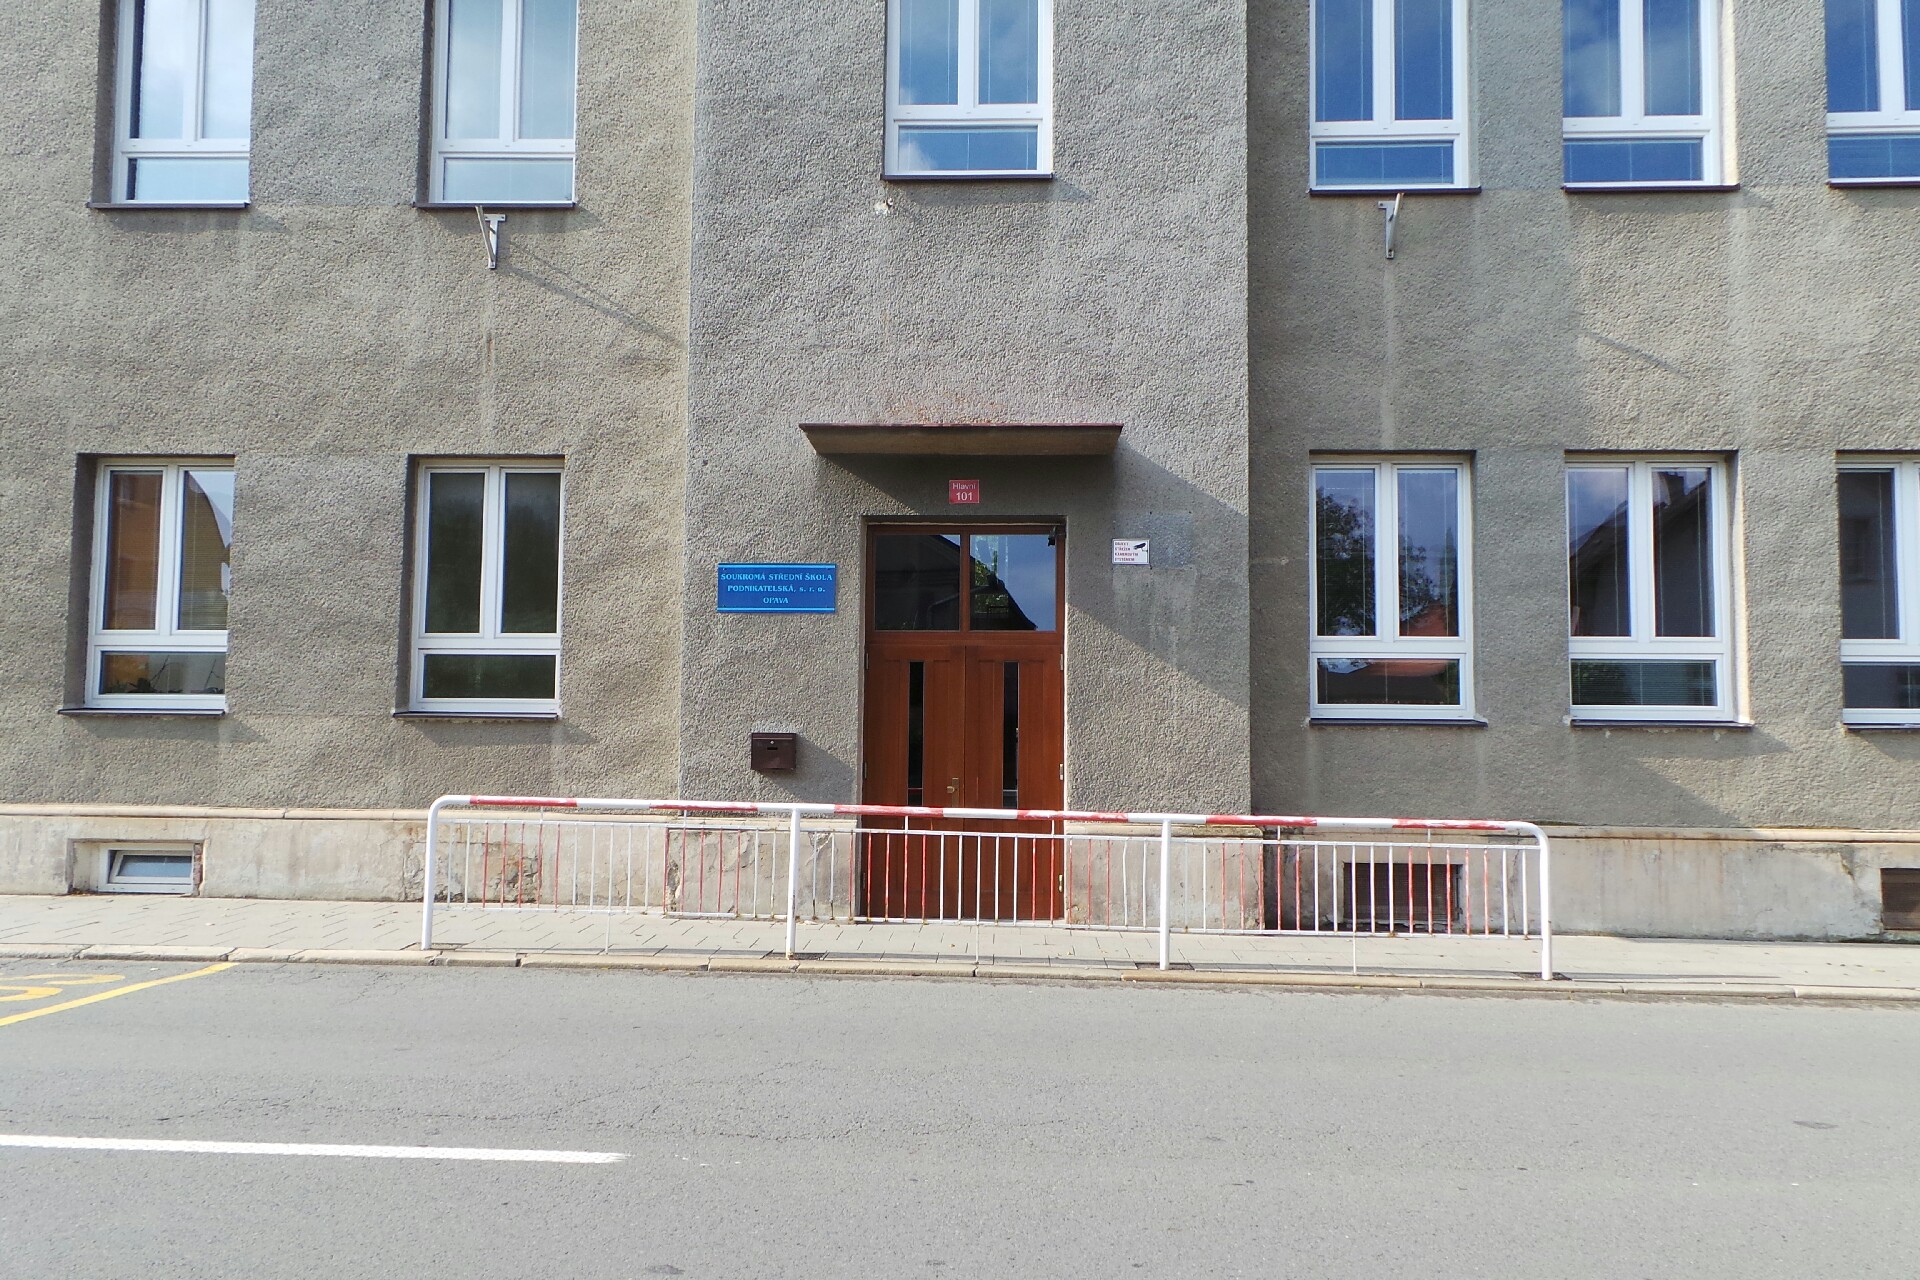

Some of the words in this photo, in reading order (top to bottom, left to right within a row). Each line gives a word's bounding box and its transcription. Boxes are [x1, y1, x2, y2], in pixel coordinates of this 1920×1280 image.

[956, 491, 973, 501] 101
[720, 572, 766, 581] SOUKROMÁ
[768, 572, 803, 581] STŘEDNÍ
[804, 572, 833, 581] ŠKOLA
[727, 584, 797, 593] PODNIKATELSKÁ,
